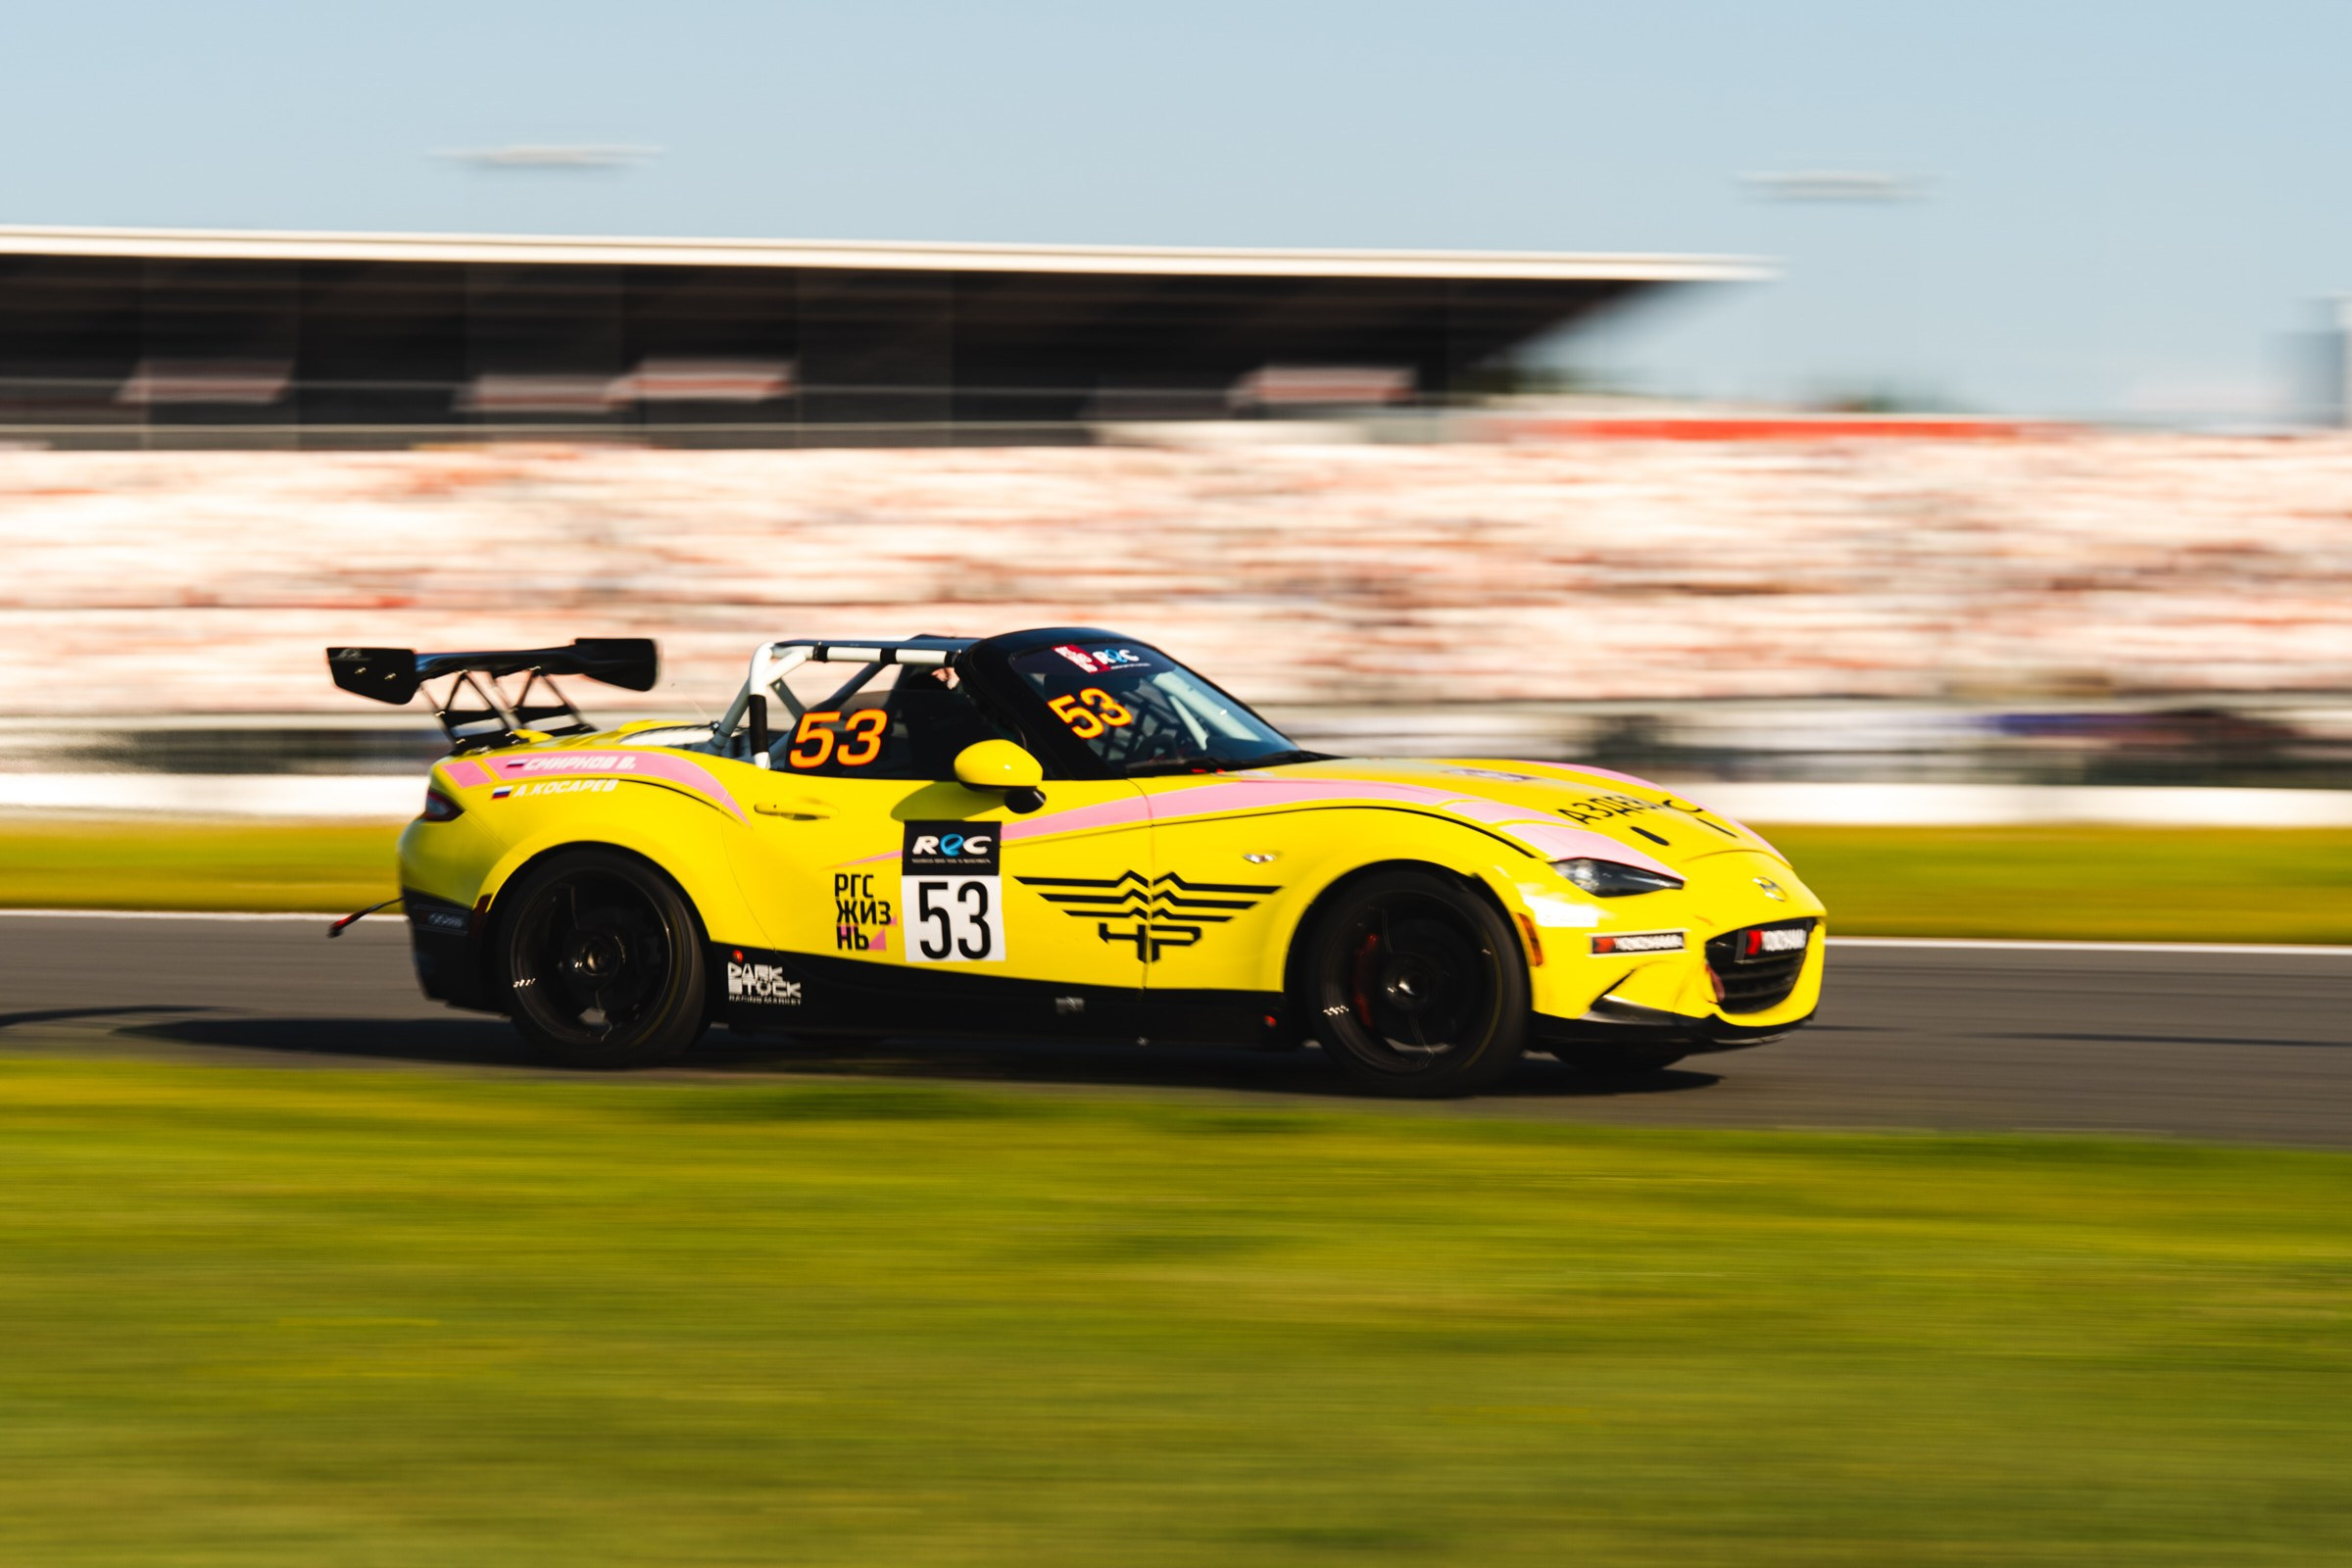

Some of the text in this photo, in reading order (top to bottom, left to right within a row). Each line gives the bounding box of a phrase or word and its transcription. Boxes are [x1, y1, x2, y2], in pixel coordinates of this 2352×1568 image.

[1047, 687, 1133, 740] 53
[789, 709, 888, 768] 53
[835, 873, 874, 898] РГС
[836, 900, 892, 925] ЖИЗ
[918, 880, 992, 959] 53
[836, 925, 870, 950] НЬ
